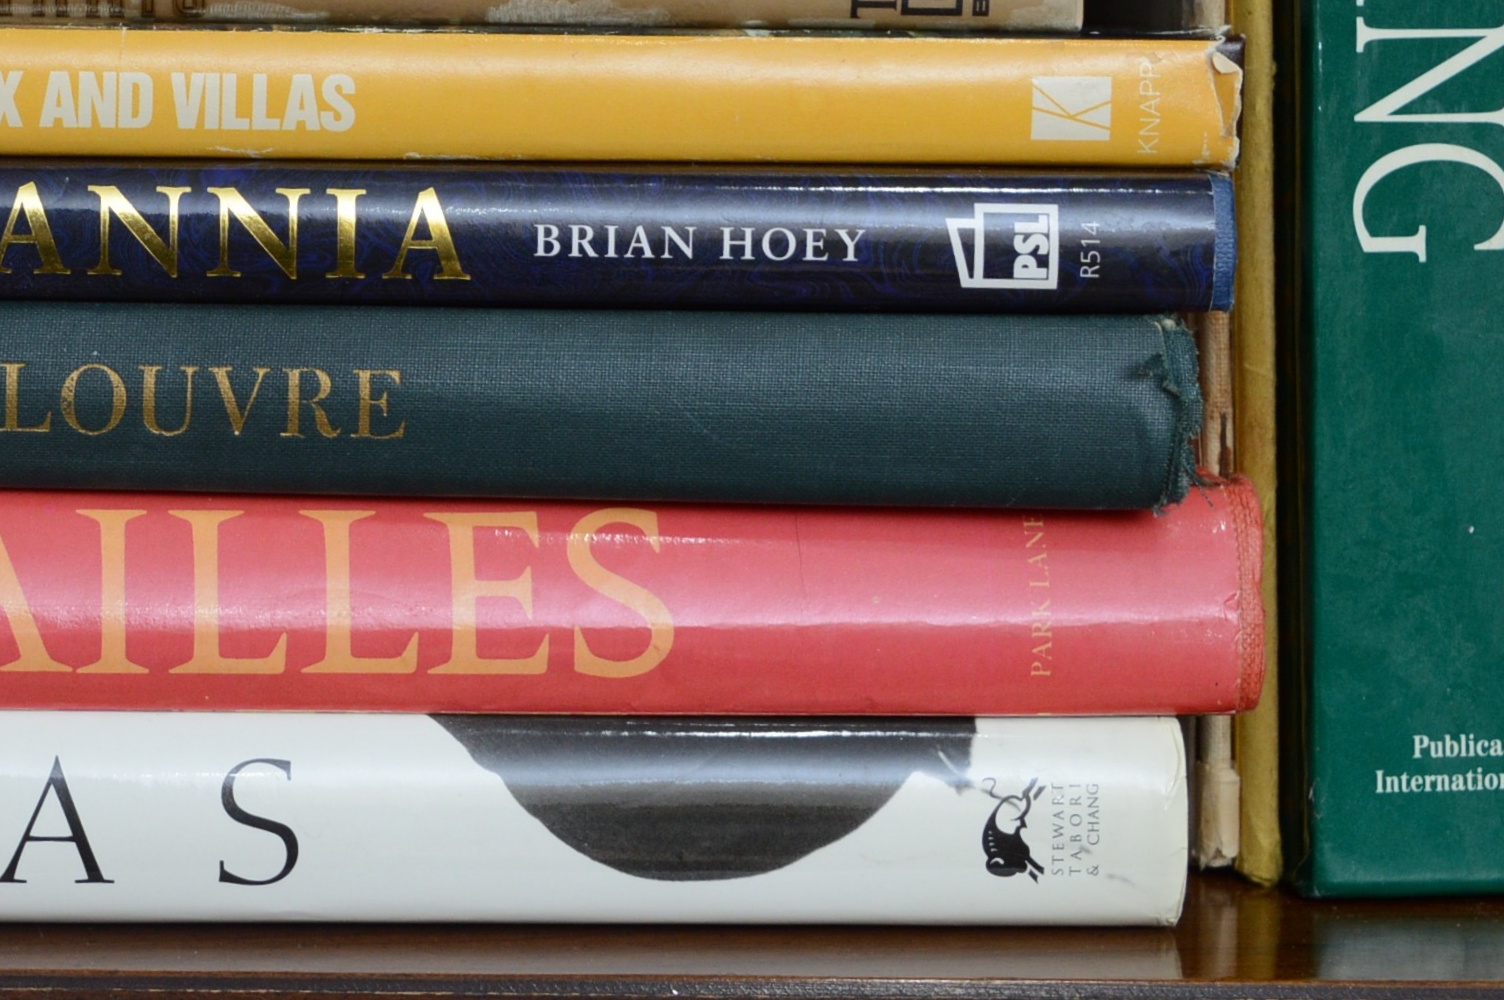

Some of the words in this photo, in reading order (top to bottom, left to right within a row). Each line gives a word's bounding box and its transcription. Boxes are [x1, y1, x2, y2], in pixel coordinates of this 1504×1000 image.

[39, 70, 153, 130] AND
[172, 72, 357, 133] VILLAS
[1137, 56, 1161, 154] KNAPP
[534, 223, 697, 261] BRIAN
[719, 226, 867, 263] HOEY
[1013, 215, 1050, 279] PSL
[1079, 220, 1101, 279] R514
[1022, 514, 1051, 588] LANE
[1030, 598, 1053, 677] PARK
[1050, 782, 1065, 877] STEWART
[1068, 783, 1082, 877] TABORI
[1086, 783, 1100, 846] CHANG
[1086, 864, 1100, 877] &
